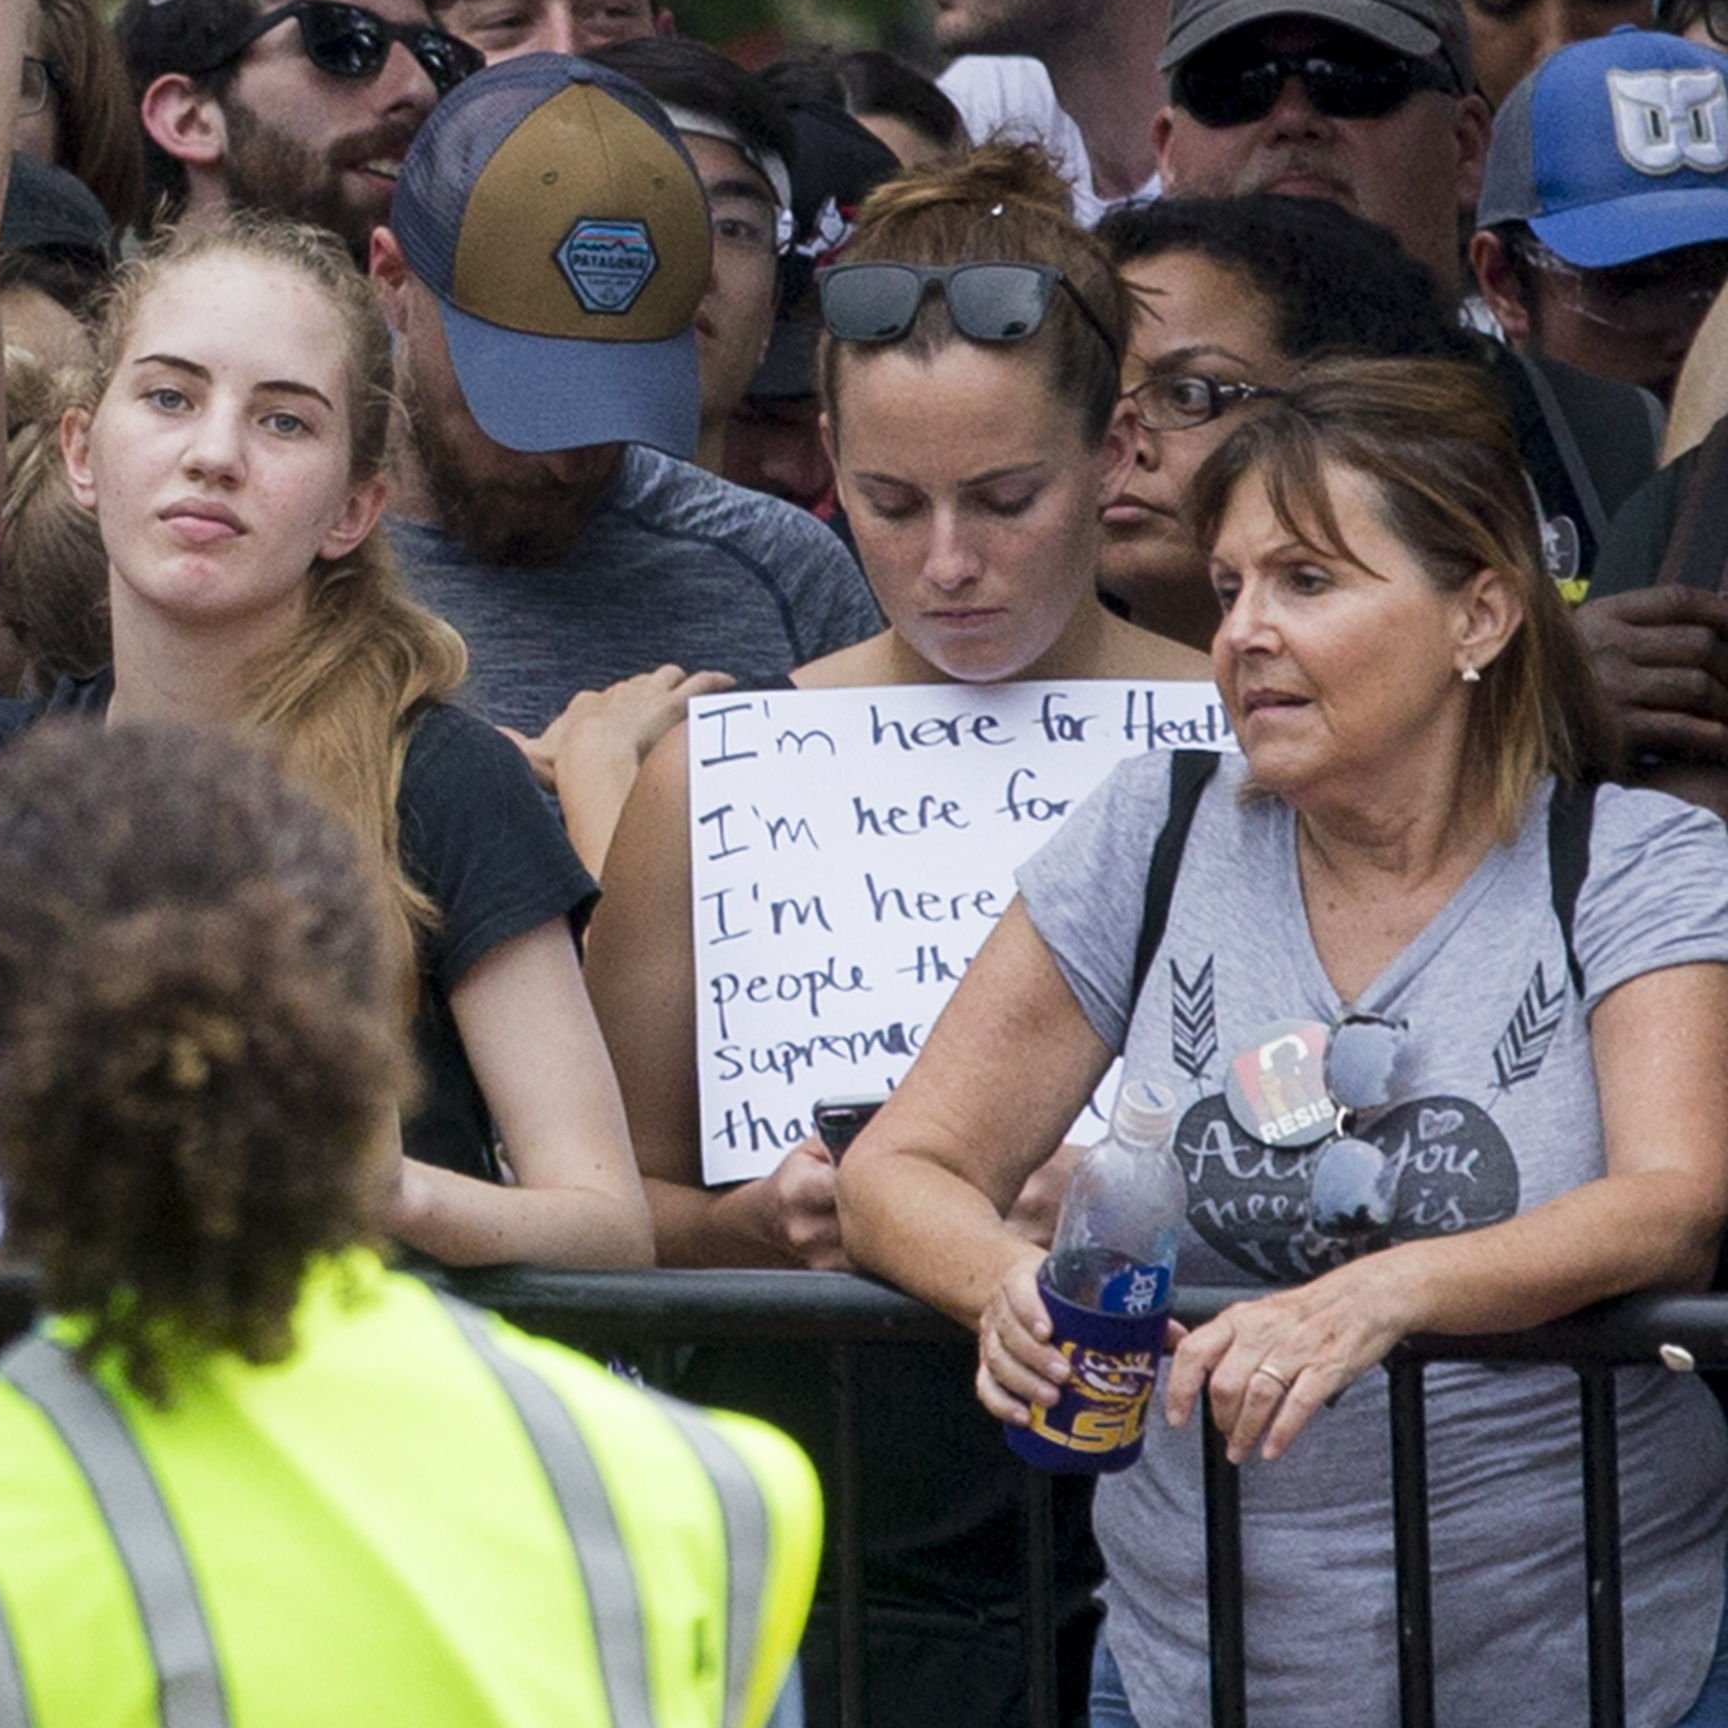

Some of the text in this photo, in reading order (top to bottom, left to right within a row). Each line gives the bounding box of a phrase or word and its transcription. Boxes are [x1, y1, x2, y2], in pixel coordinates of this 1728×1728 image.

[572, 252, 647, 270] PATAGONIA
[697, 699, 836, 768] I'm
[869, 703, 1017, 751] here
[1040, 692, 1100, 744] for
[698, 768, 1074, 862] I'm here for
[701, 873, 1004, 946] I'm here
[710, 956, 873, 1041] people
[712, 1100, 816, 1152] tha
[1259, 1097, 1336, 1145] RESIS
